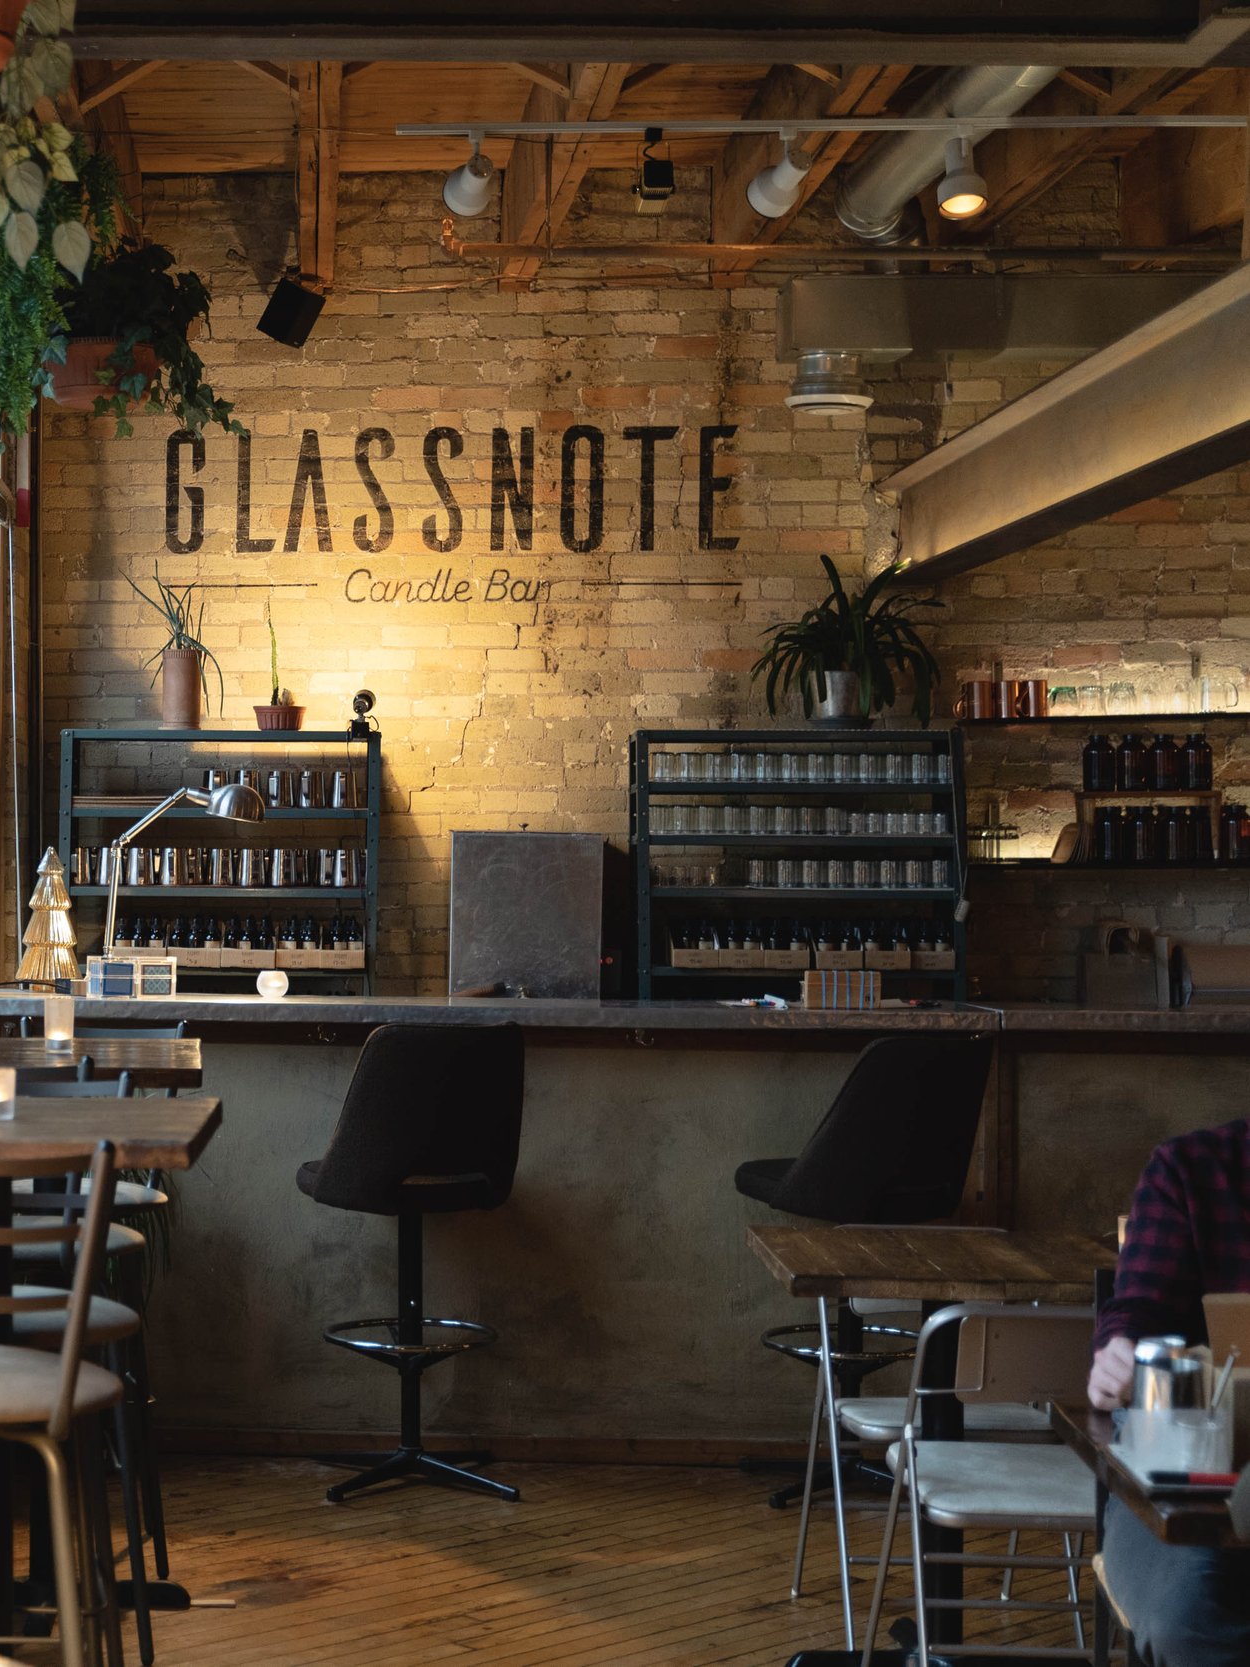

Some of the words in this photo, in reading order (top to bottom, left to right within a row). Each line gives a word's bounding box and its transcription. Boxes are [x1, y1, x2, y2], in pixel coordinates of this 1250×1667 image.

[165, 425, 739, 554] GLASSNOTE
[345, 568, 472, 603] Candle
[484, 569, 551, 603] Bar
